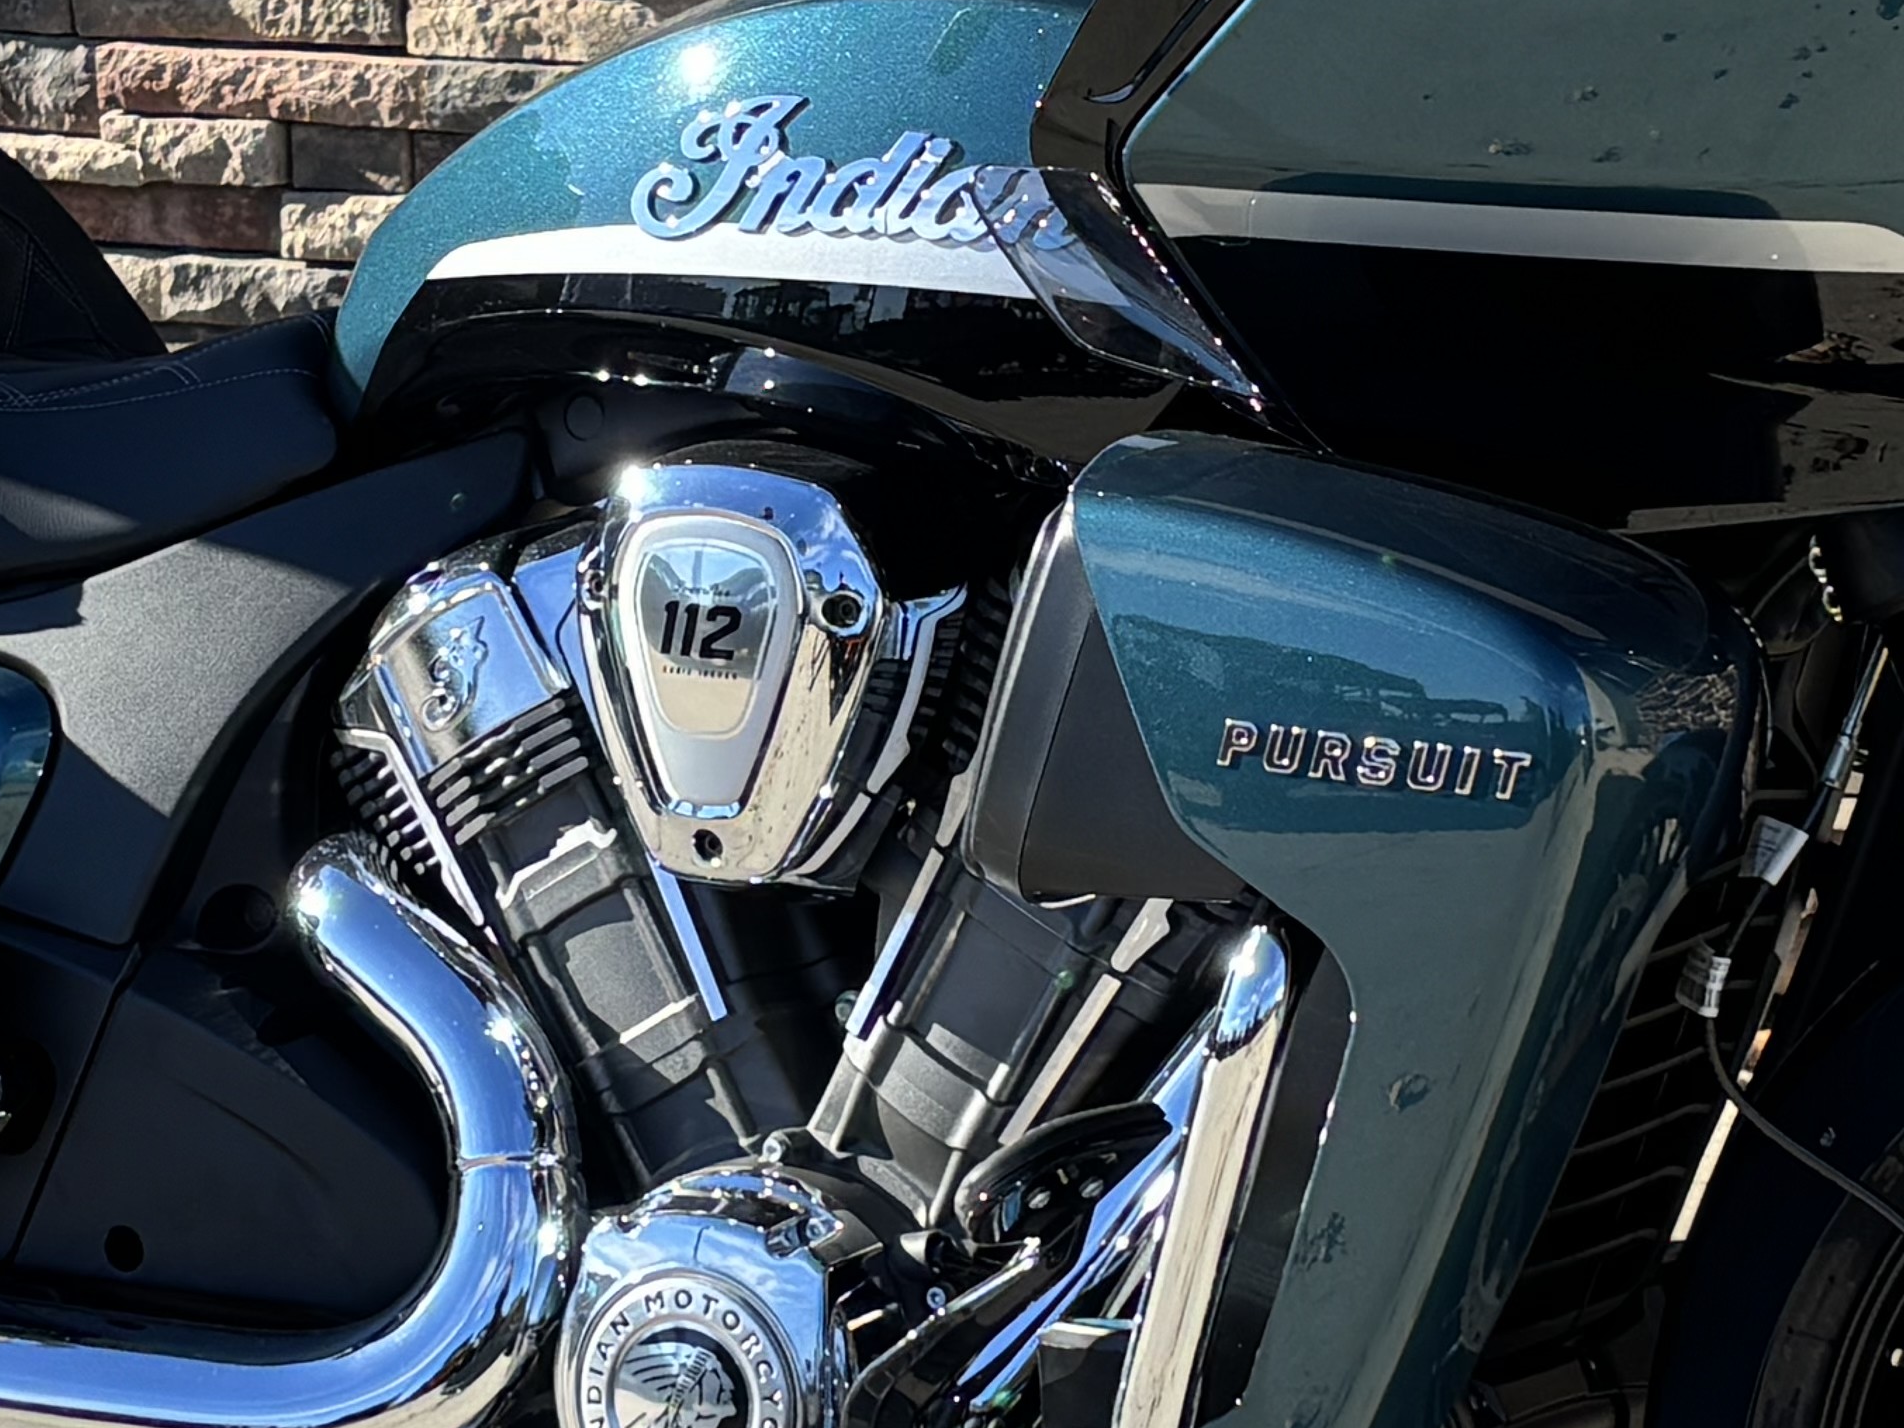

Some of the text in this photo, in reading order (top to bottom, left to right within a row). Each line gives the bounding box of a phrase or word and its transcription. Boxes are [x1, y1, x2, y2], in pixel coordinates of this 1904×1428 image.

[630, 94, 1080, 251] Indian
[660, 600, 743, 661] 112
[1216, 717, 1533, 801] PURSUIT
